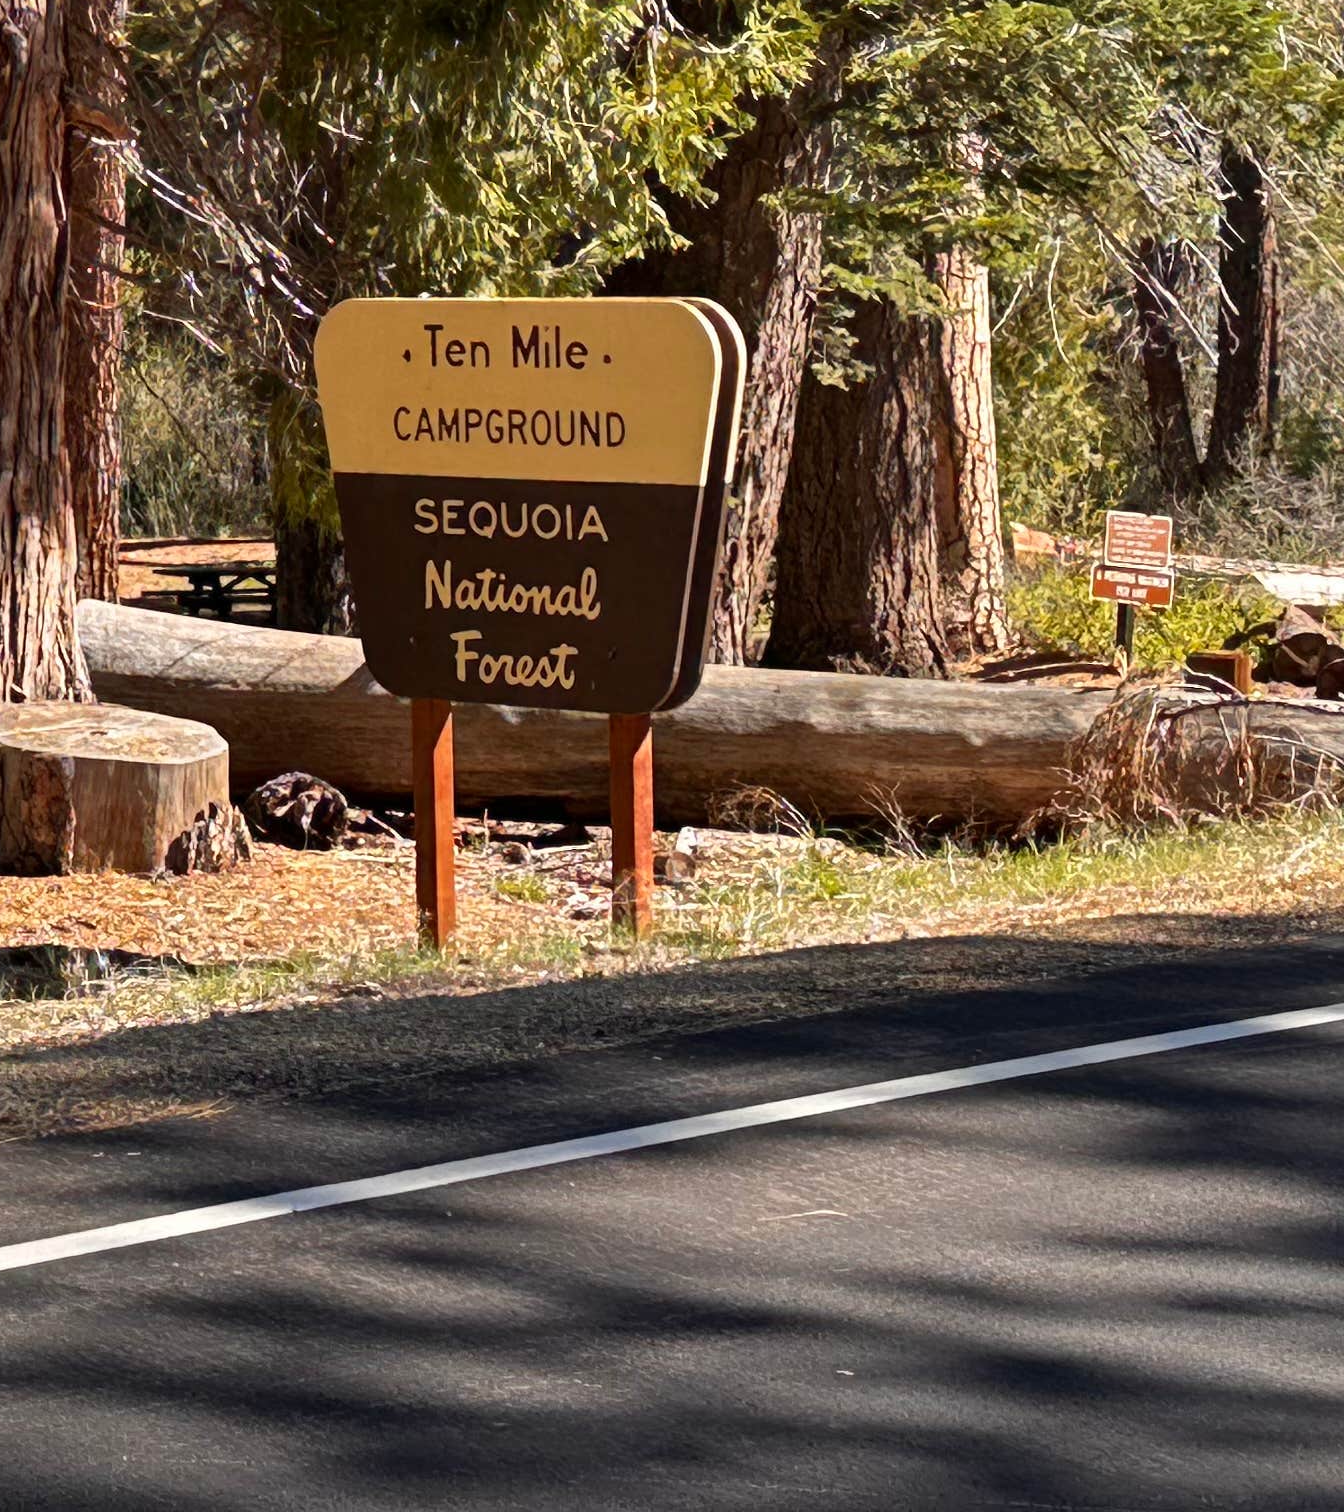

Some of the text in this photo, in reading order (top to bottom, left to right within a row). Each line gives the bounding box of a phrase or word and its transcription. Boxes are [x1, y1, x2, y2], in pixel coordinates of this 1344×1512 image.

[424, 324, 589, 369] Ten Mile
[393, 406, 626, 448] CAMPGROUND
[414, 498, 609, 543] SEQUOIA
[424, 559, 601, 621] National
[449, 629, 579, 690] Forest
